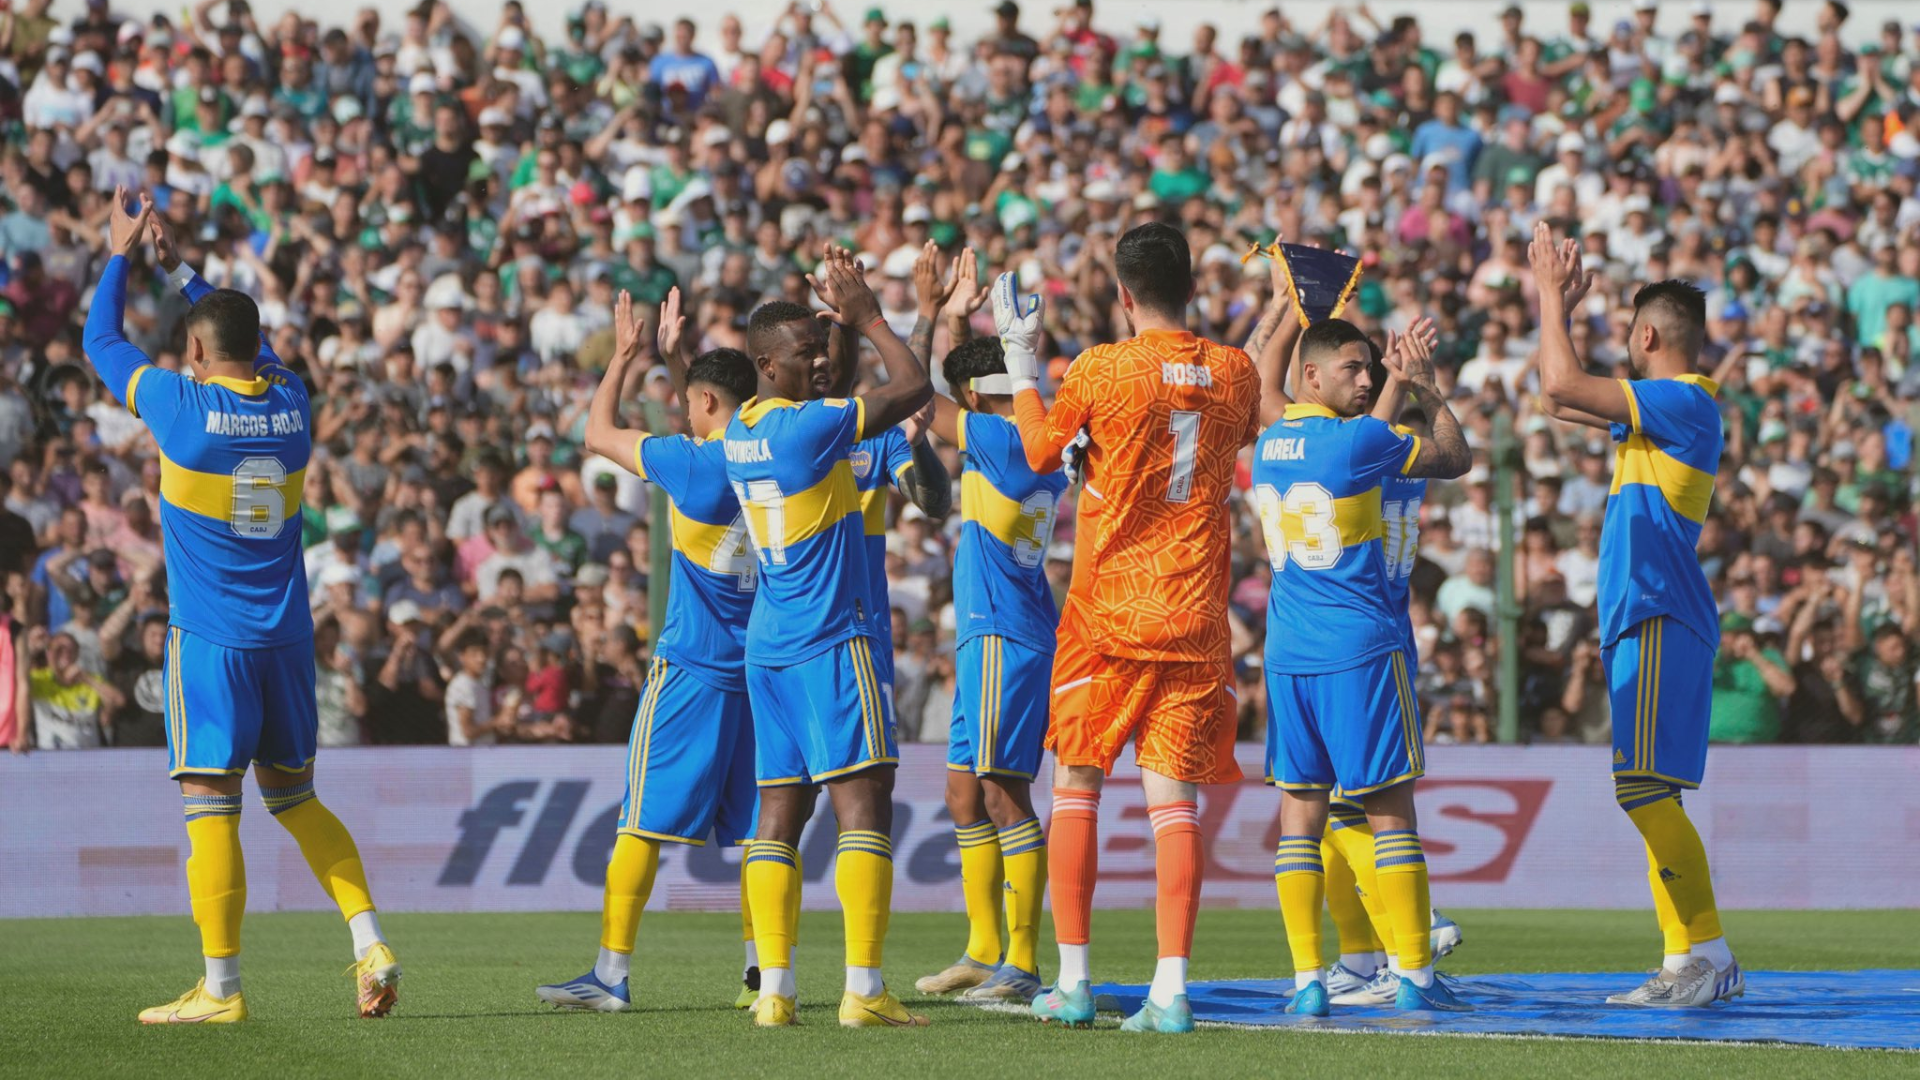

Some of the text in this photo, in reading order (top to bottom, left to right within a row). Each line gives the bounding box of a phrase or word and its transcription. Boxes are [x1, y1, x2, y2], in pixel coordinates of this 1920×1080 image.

[1162, 362, 1212, 388] ROSSI
[206, 409, 304, 436] MARCOS ROJO
[723, 438, 773, 463] DVINCULA
[1168, 410, 1201, 503] 1
[1262, 437, 1305, 461] VARELA
[231, 456, 287, 539] 6
[731, 480, 788, 566] 17
[1012, 490, 1058, 568] 3
[709, 508, 758, 593] 4
